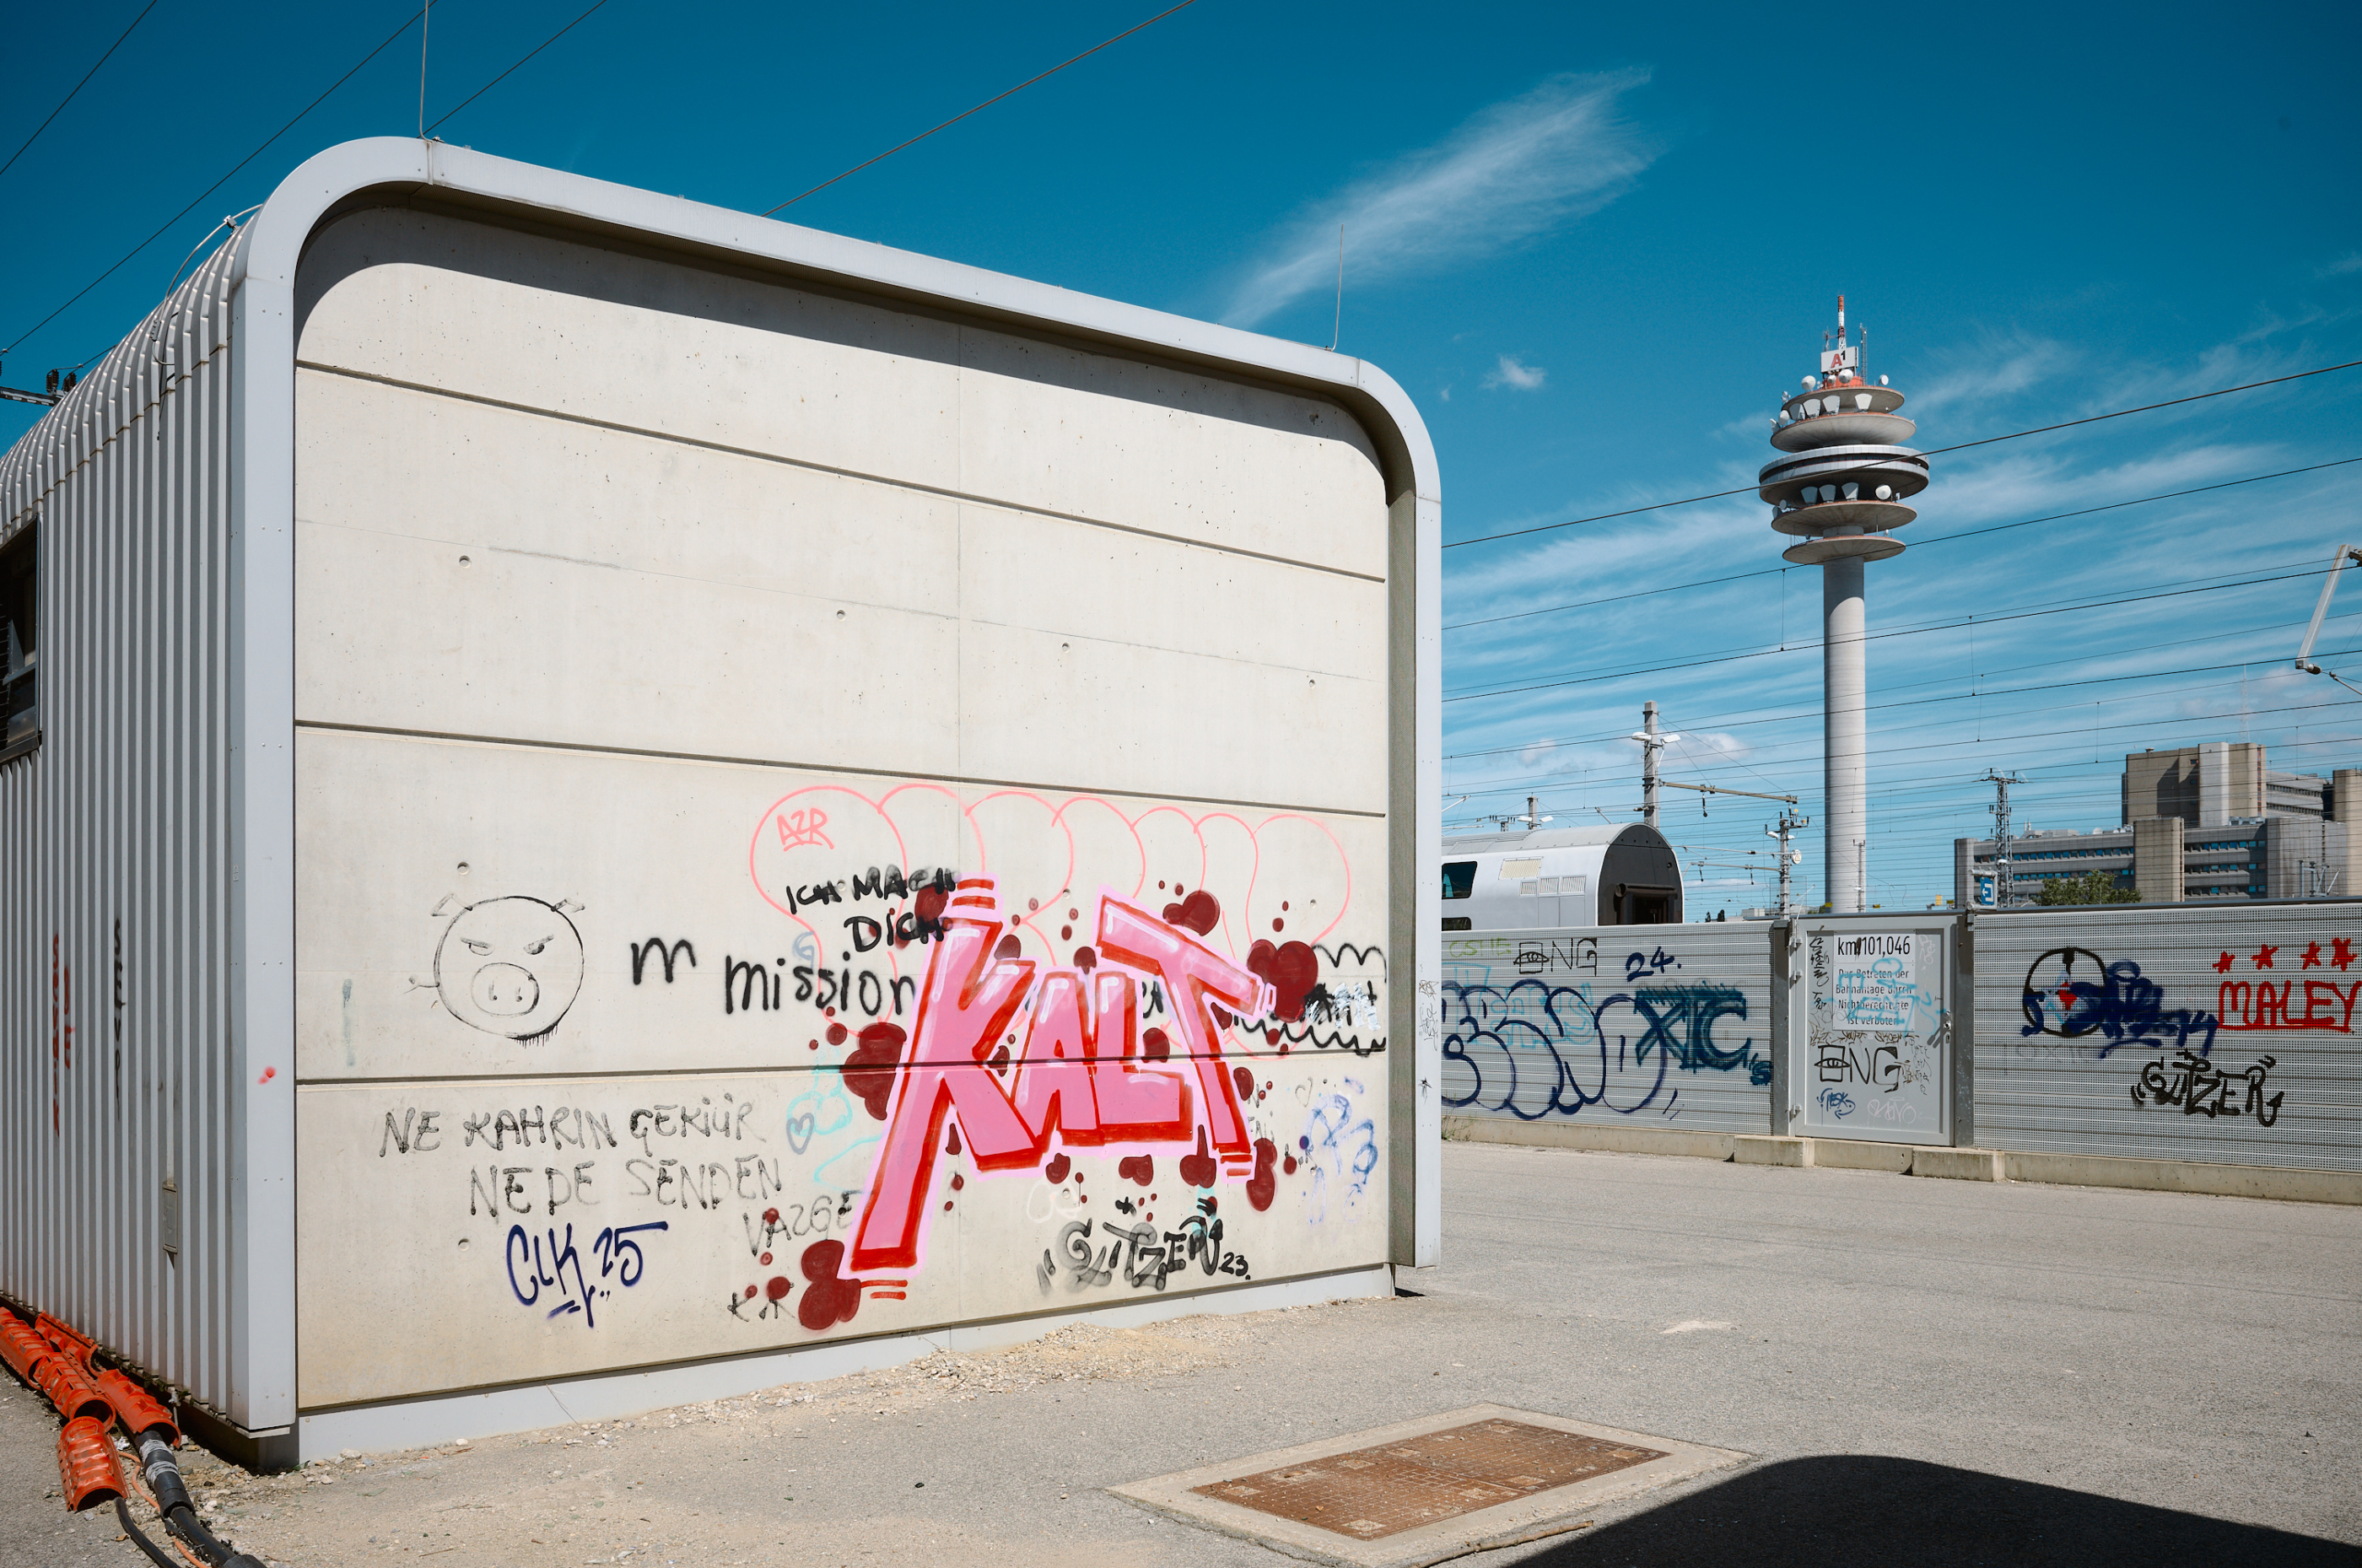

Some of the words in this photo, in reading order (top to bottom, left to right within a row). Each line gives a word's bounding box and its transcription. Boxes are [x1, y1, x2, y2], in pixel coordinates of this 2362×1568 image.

[1831, 350, 1846, 369] A1
[1838, 937, 1857, 956] km
[1862, 935, 1911, 958] 101,046
[1839, 968, 1853, 978] Das
[1856, 968, 1892, 978] Betreten
[1896, 969, 1909, 978] der
[1836, 983, 1885, 996] Bahnanlage
[1888, 983, 1912, 994] durch
[1838, 999, 1909, 1011] Nichtberechtgte
[1847, 1015, 1858, 1025] ist
[844, 887, 1265, 1274] KALT
[380, 1107, 441, 1157] NE
